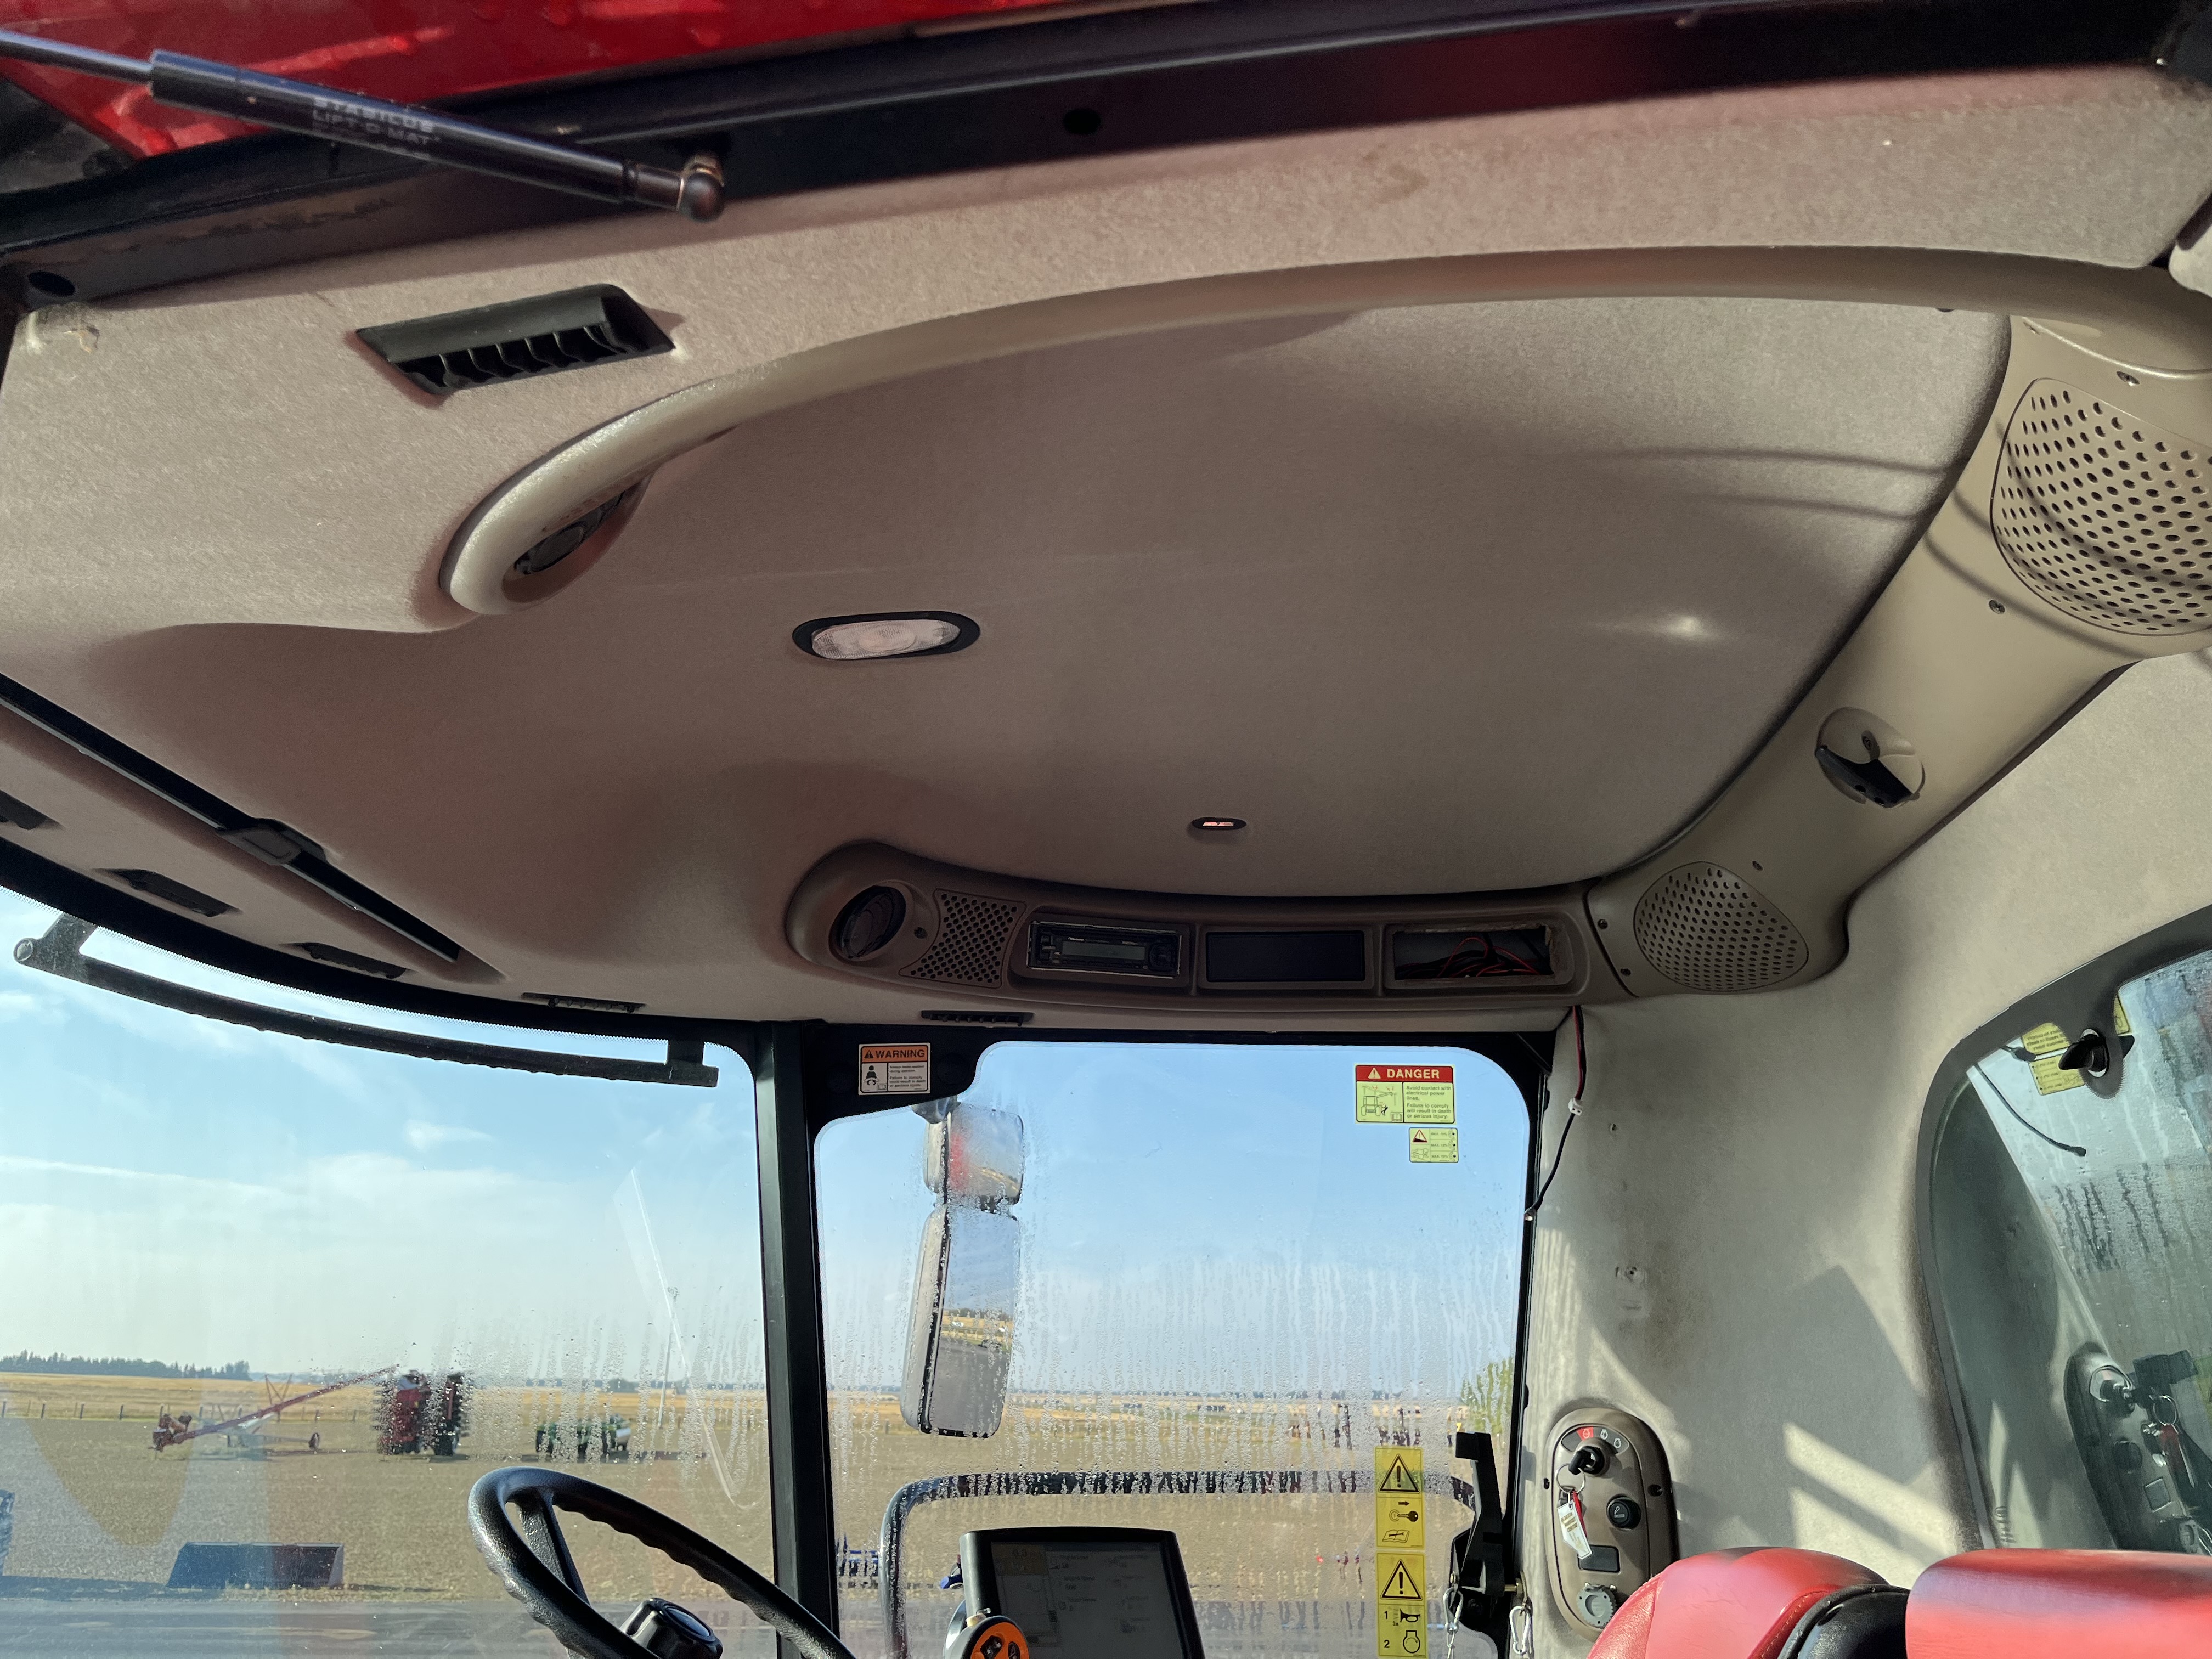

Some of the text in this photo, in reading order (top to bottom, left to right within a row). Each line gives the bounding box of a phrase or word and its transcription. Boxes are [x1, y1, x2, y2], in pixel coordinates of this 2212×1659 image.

[875, 1049, 924, 1058] WARNING
[1387, 1069, 1440, 1079] DANGER
[1384, 1611, 1388, 1619] 1
[1384, 1640, 1390, 1648] 2
